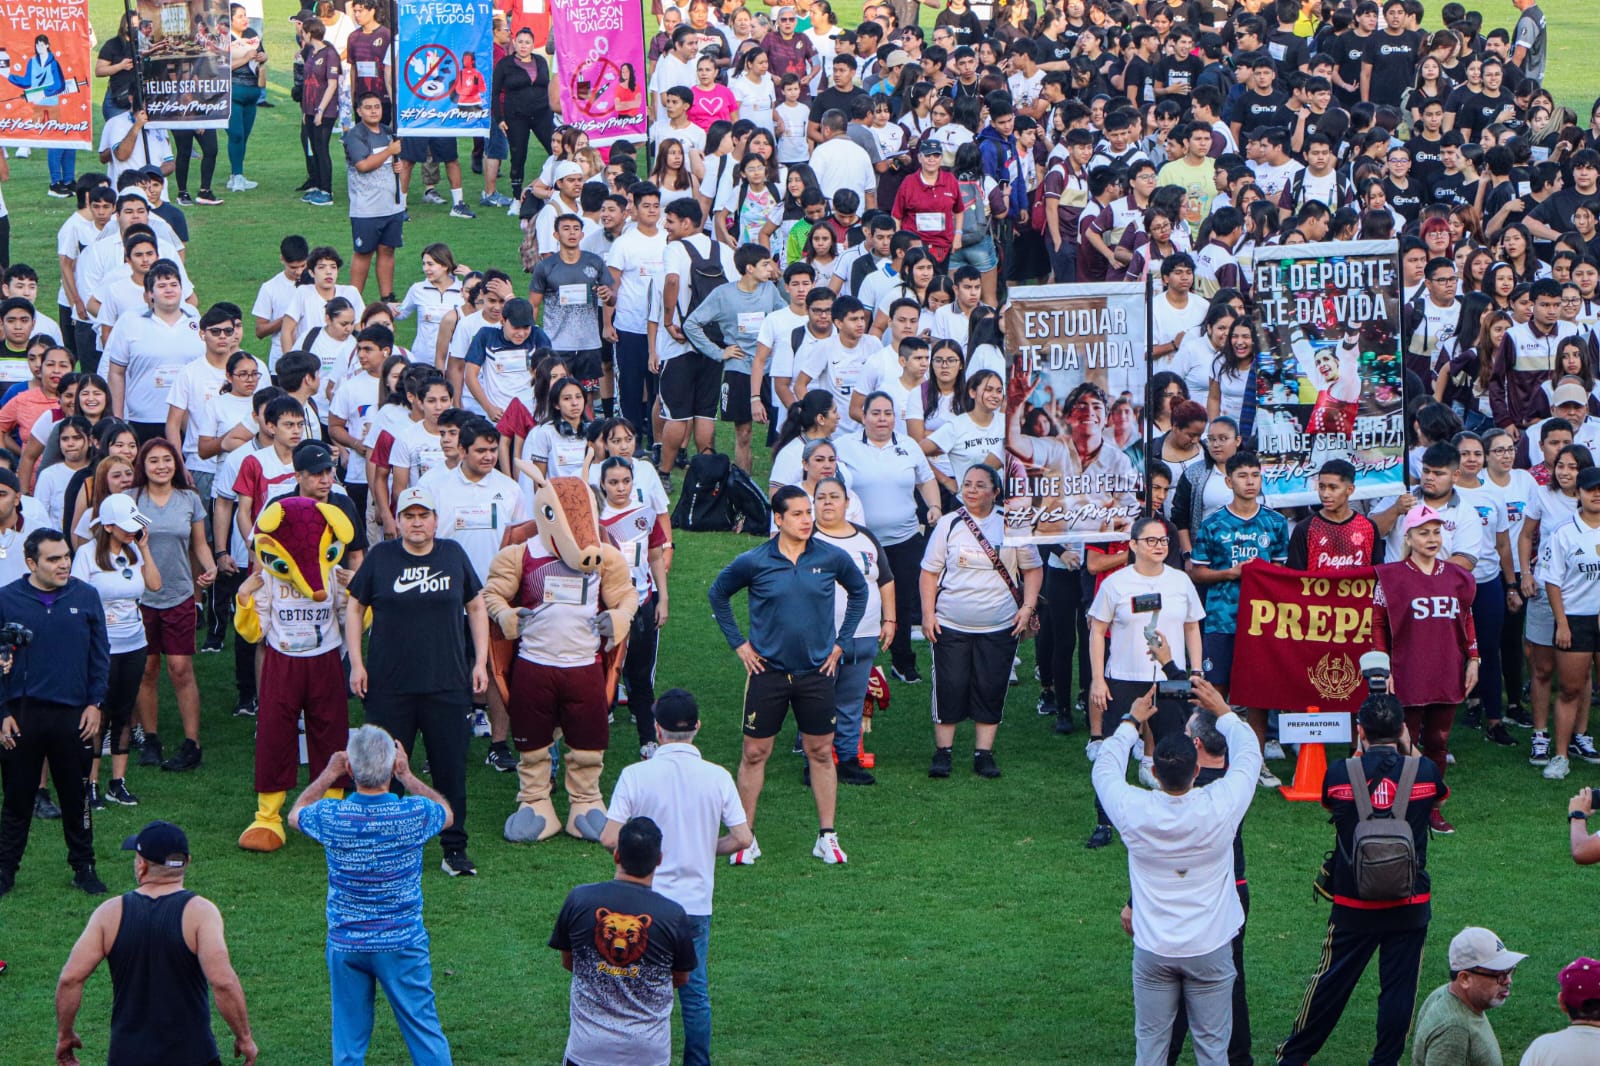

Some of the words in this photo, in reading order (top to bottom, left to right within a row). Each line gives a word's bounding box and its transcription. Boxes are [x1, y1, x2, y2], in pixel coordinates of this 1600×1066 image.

[7, 4, 25, 16] LA
[28, 6, 85, 19] PRIMERA
[420, 3, 464, 13] AFECTA
[478, 4, 489, 14] TI
[600, 5, 623, 18] SON
[10, 18, 31, 30] TE
[416, 15, 424, 24] Y
[425, 15, 434, 24] A
[180, 80, 195, 93] SER
[1257, 266, 1283, 292] EL
[1291, 260, 1391, 291] DEPORTE
[1263, 299, 1289, 326] TE
[1297, 297, 1327, 324] DA
[1334, 294, 1388, 321] VIDA
[1025, 309, 1127, 338] ESTUDIAR
[1019, 345, 1042, 372] TE
[1050, 343, 1079, 370] DA
[1086, 341, 1134, 369] VIDA
[964, 438, 983, 449] NEW
[1316, 432, 1347, 451] SER
[1064, 475, 1092, 495] SER
[1007, 502, 1142, 530] #YoSoyPrepa2
[1231, 545, 1258, 558] Euro
[401, 567, 430, 580] JUST
[1300, 577, 1330, 597] YO
[279, 609, 314, 621] CBTIS
[1248, 599, 1374, 644] PREPA
[364, 802, 400, 812] EXCHANGE
